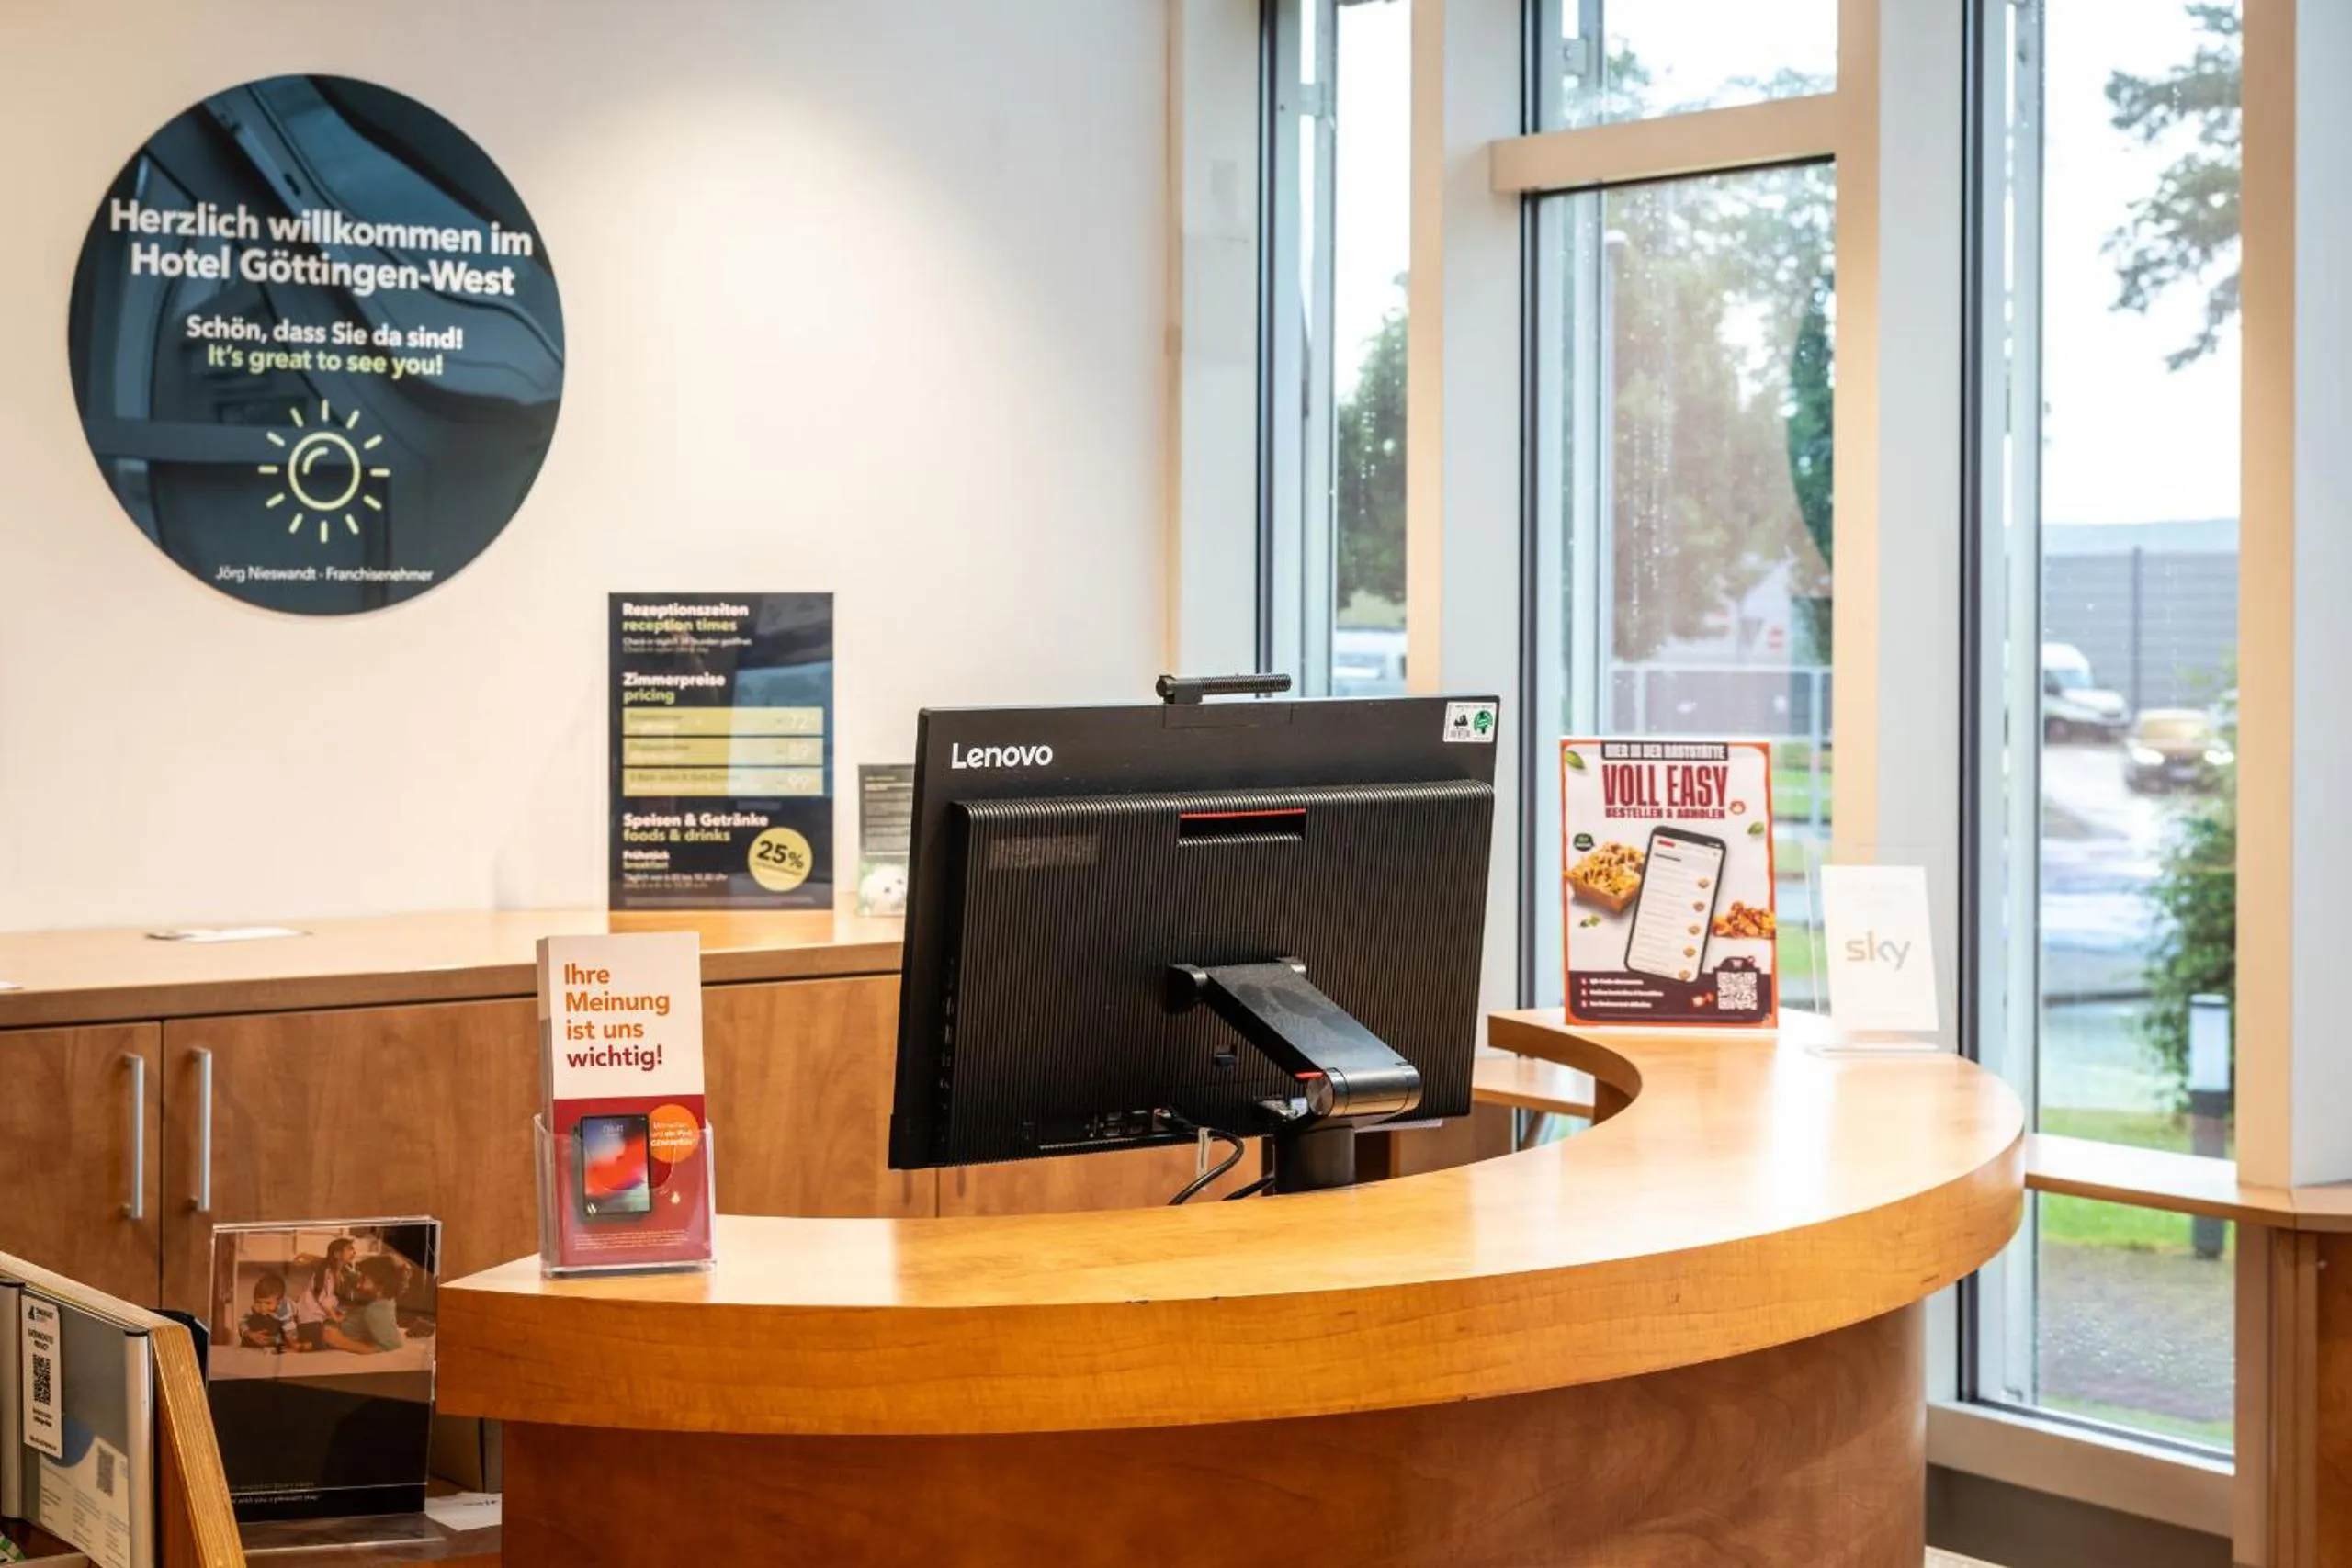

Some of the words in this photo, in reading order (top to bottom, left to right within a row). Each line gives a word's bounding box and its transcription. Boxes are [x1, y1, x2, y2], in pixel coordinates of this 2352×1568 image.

[109, 197, 260, 241] Herzlich
[267, 209, 483, 254] willkommen
[490, 221, 533, 256] im
[130, 242, 230, 279] Hotel
[240, 249, 516, 296] Göttingen-West
[186, 314, 268, 344] Schön,
[272, 318, 327, 344] dass
[332, 321, 368, 345] Sie
[372, 323, 402, 348] da
[407, 326, 464, 350] sind!
[208, 344, 244, 368] It's
[248, 349, 313, 374] great
[318, 350, 341, 371] to
[346, 355, 387, 375] see
[391, 354, 444, 380] you!
[216, 564, 246, 583] Jörg
[248, 565, 318, 581] Nieswandt
[325, 566, 434, 581] Franchisenehmer
[622, 602, 750, 619] Rezeptionszeiten
[622, 618, 694, 635] reception
[695, 617, 738, 631] times
[622, 671, 727, 690] Zimmerpreise
[622, 689, 675, 705] pricing
[951, 742, 1054, 769] Lenovo
[1601, 764, 1659, 807] VOLL
[1667, 764, 1728, 807] EASY
[622, 812, 681, 829] Speisen
[684, 812, 697, 827] &
[699, 812, 770, 827] Getränke
[1605, 807, 1663, 818] BESTELLEN
[622, 829, 666, 842] foods
[669, 829, 682, 841] &
[684, 829, 731, 842] drinks
[756, 840, 806, 870] 25%
[1844, 929, 1912, 972] sky
[563, 963, 611, 985] Ihre
[565, 991, 671, 1017] Meinung
[566, 1020, 595, 1041] ist
[603, 1020, 644, 1040] uns
[566, 1045, 663, 1072] wichtig!
